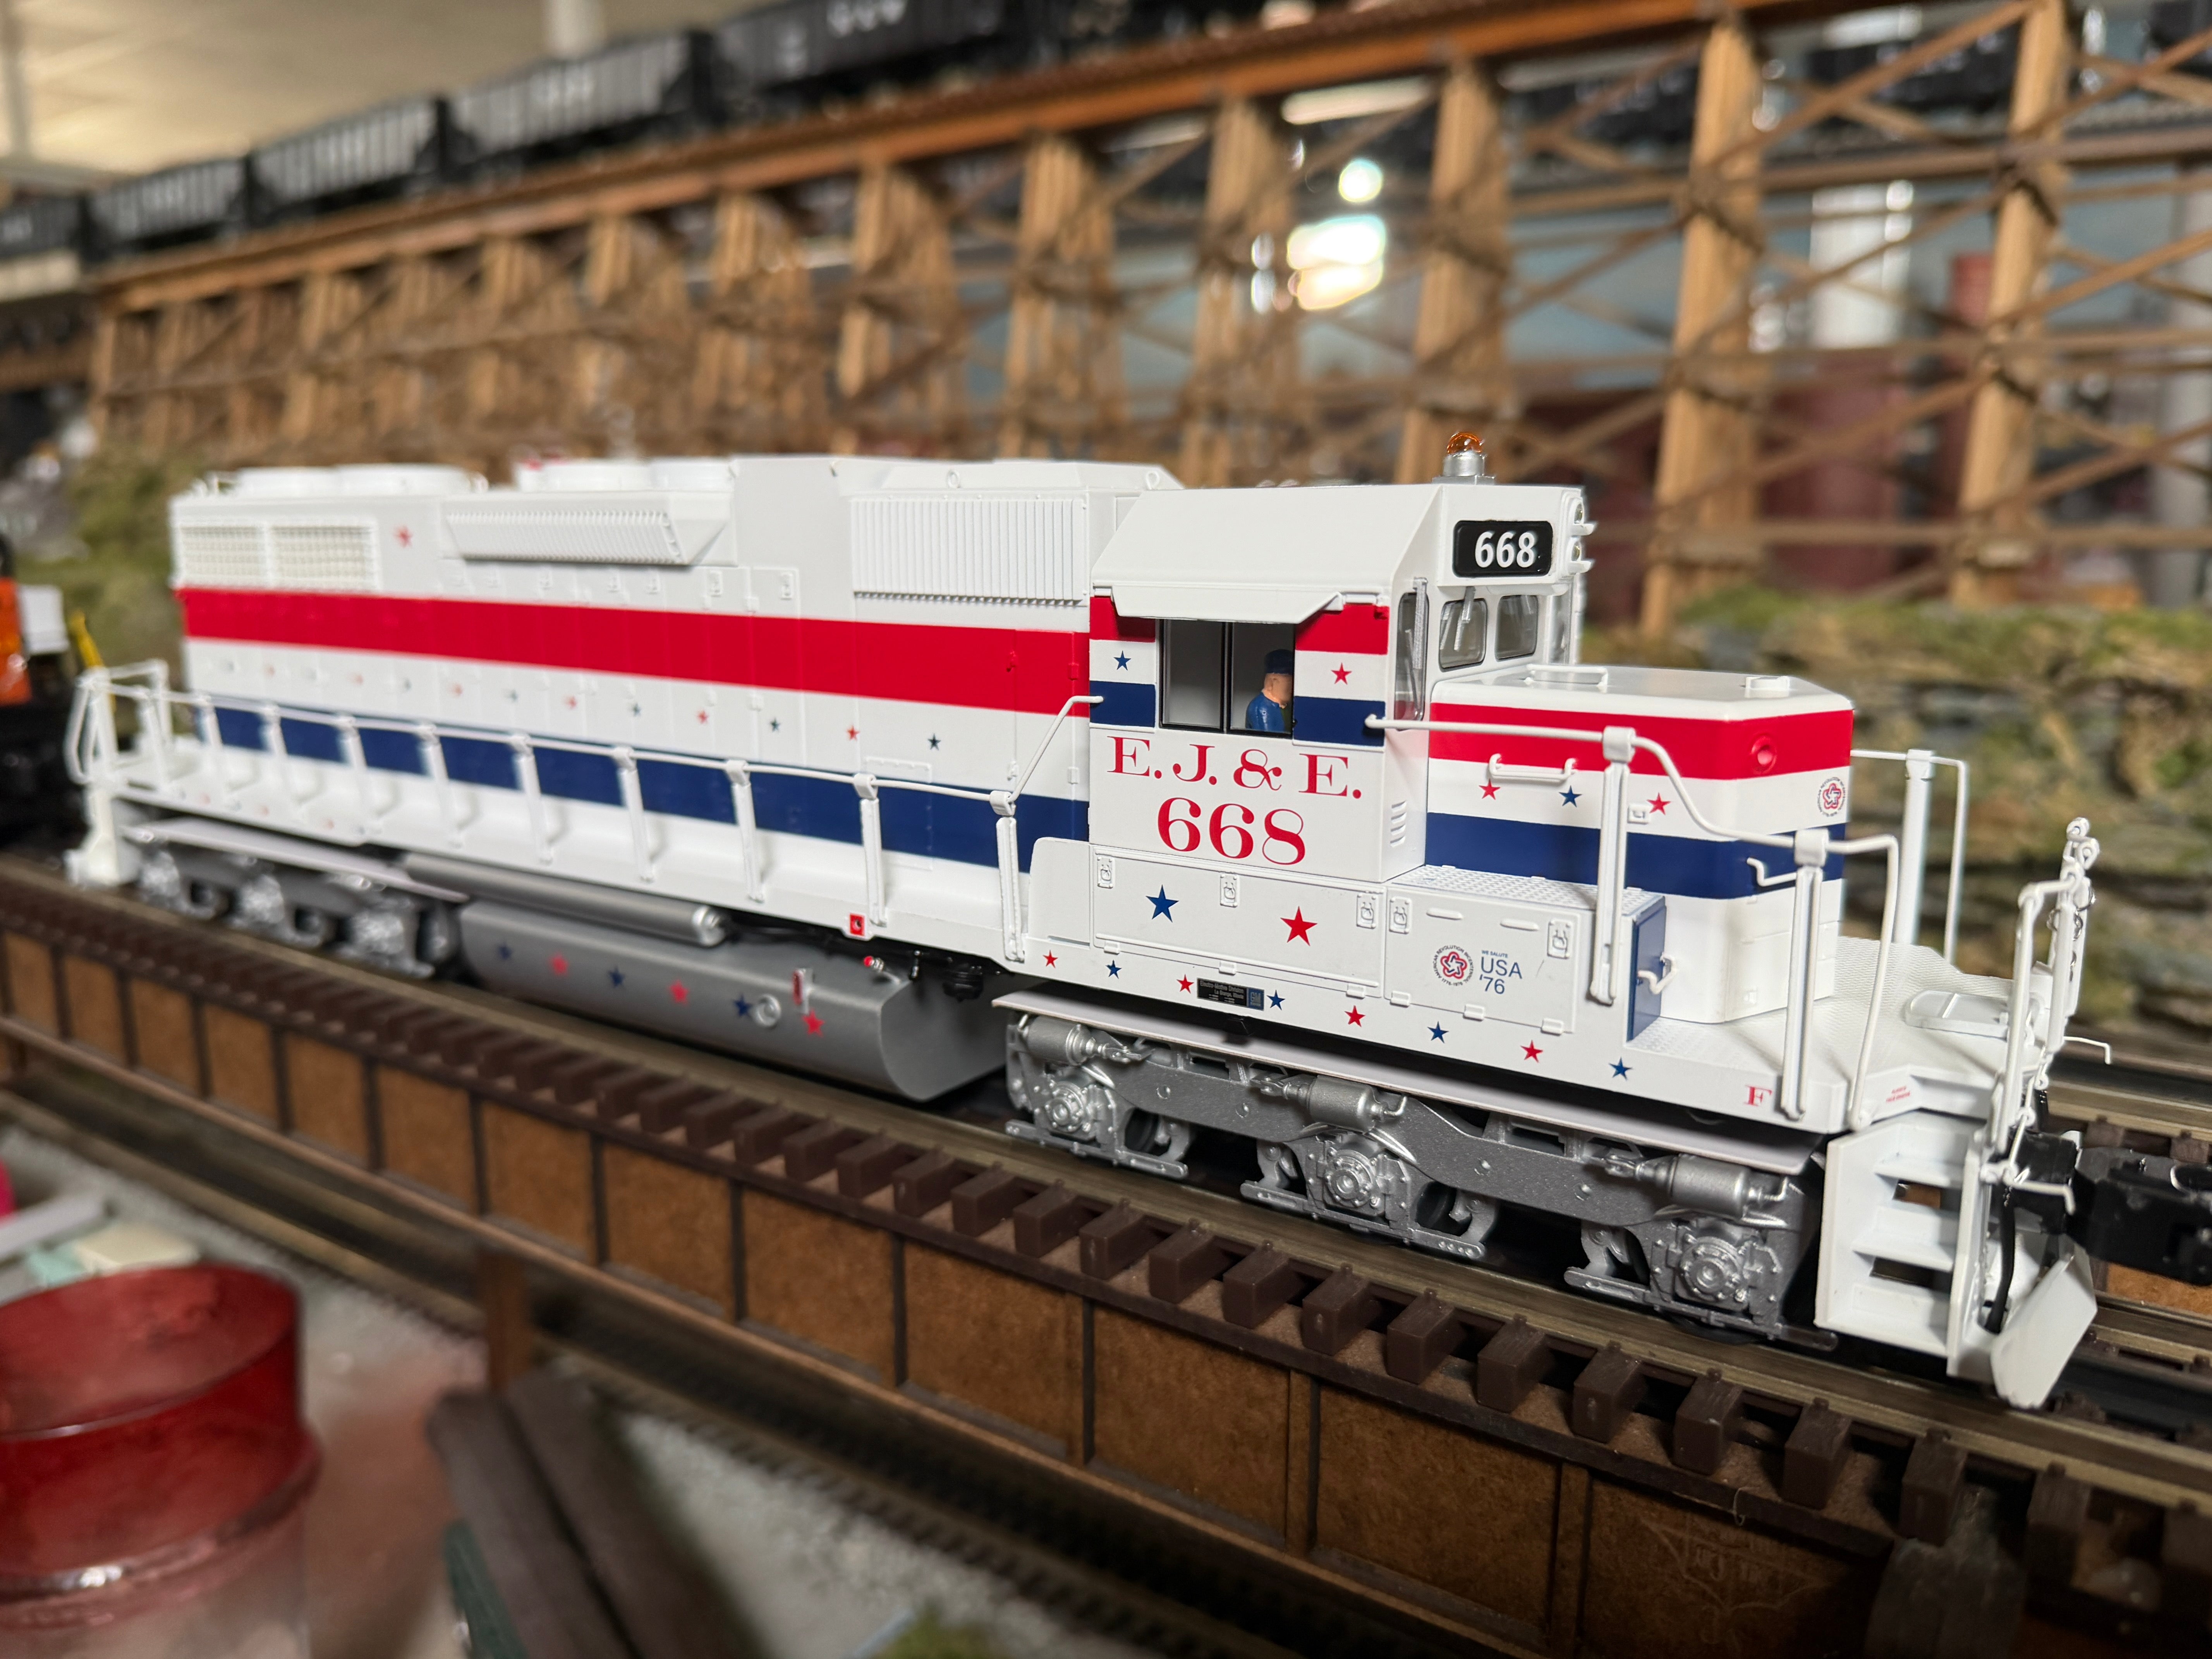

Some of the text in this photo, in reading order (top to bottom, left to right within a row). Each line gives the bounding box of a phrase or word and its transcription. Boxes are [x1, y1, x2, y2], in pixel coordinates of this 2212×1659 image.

[1475, 531, 1535, 568] 668
[1158, 797, 1306, 865] 668
[1436, 945, 1465, 955] REVOLUTION
[1480, 956, 1523, 979] USA
[1479, 974, 1505, 994] '76
[1743, 1085, 1773, 1107] F
